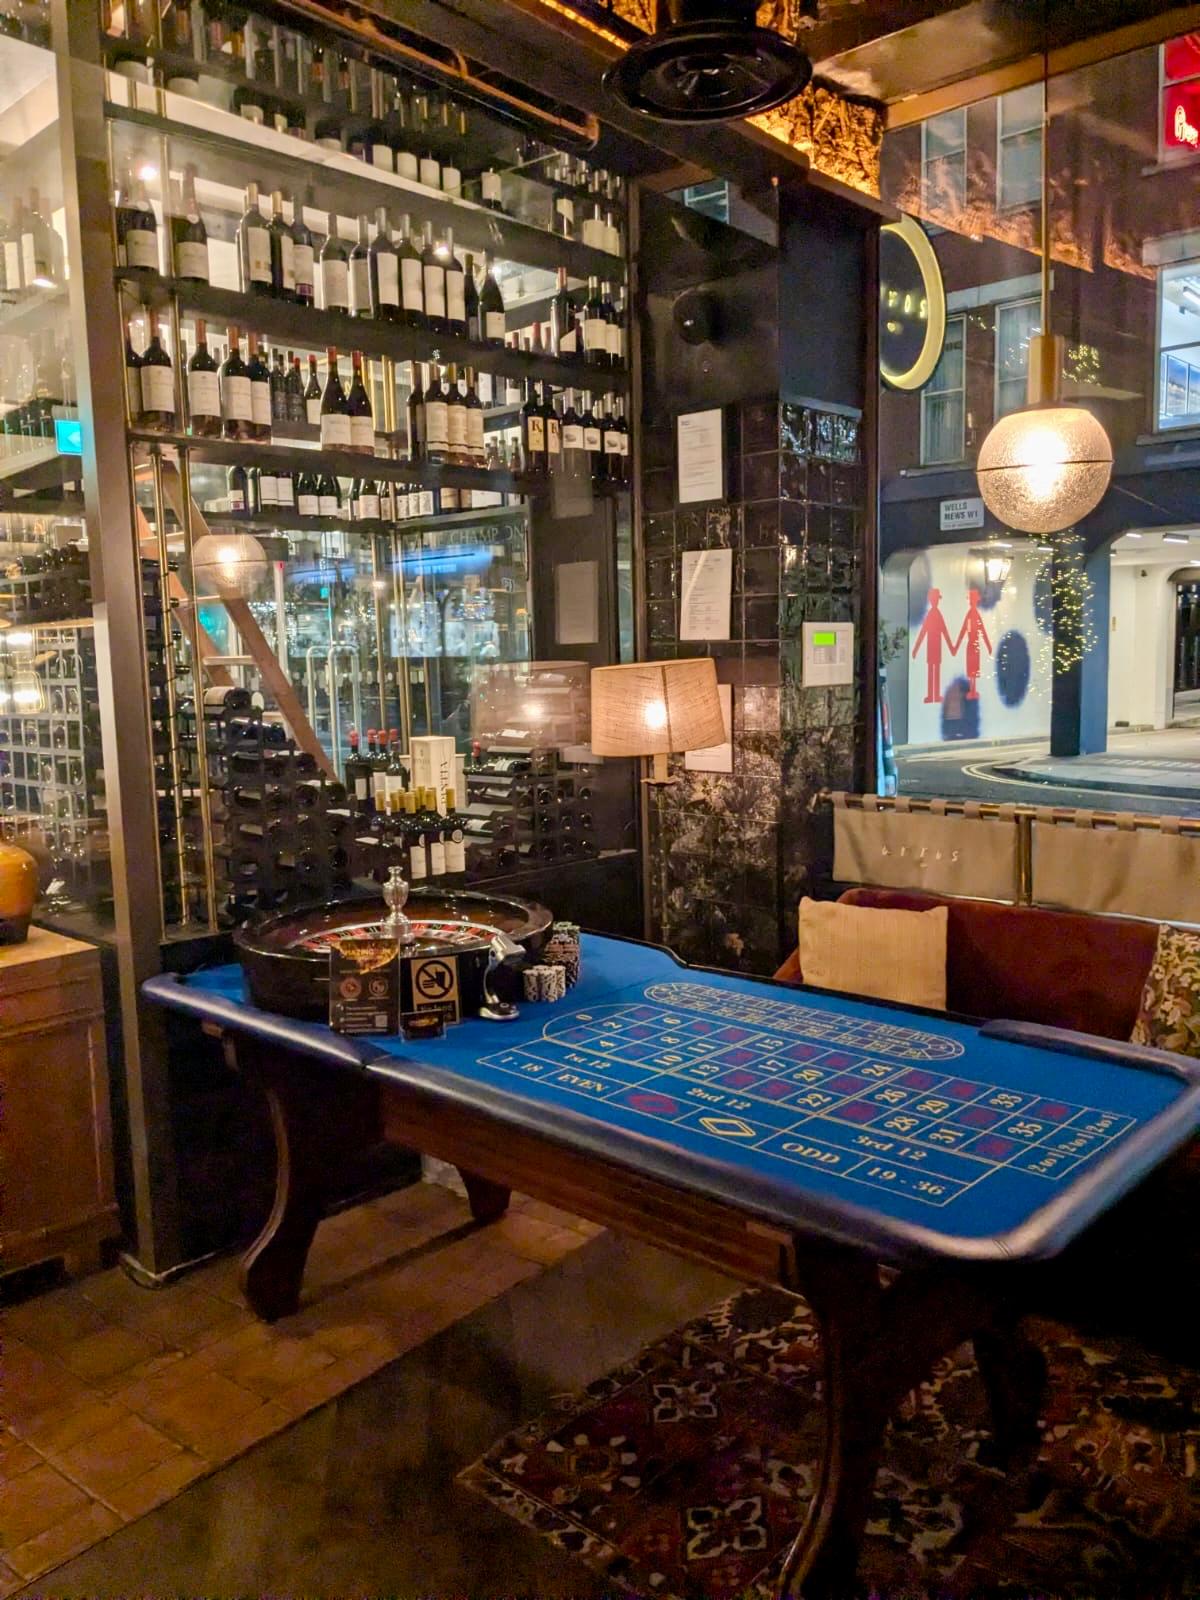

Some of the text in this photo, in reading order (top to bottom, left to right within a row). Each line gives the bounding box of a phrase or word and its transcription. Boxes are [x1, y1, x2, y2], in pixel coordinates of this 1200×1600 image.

[944, 502, 967, 511] WELLS
[450, 525, 524, 546] CHAMPON
[660, 1036, 680, 1044] 8
[756, 1038, 784, 1050] 15
[688, 1042, 716, 1054] 11
[654, 1056, 682, 1066] 10
[758, 1060, 786, 1072] 17
[690, 1064, 720, 1076] 13
[794, 1070, 824, 1082] 20
[862, 1064, 892, 1076] 24
[558, 1074, 610, 1092] EVEN
[686, 1088, 752, 1110] 2nd 12
[798, 1094, 832, 1108] 22
[876, 1088, 906, 1104] 26
[990, 1094, 1022, 1108] 33
[916, 1100, 948, 1114] 29
[884, 1116, 918, 1132] 28
[1008, 1122, 1042, 1136] 35
[930, 1128, 964, 1144] 31
[782, 1142, 840, 1164] ODD
[852, 1135, 926, 1160] 3rd 12
[868, 1168, 896, 1180] 19
[912, 1182, 946, 1194] 36
